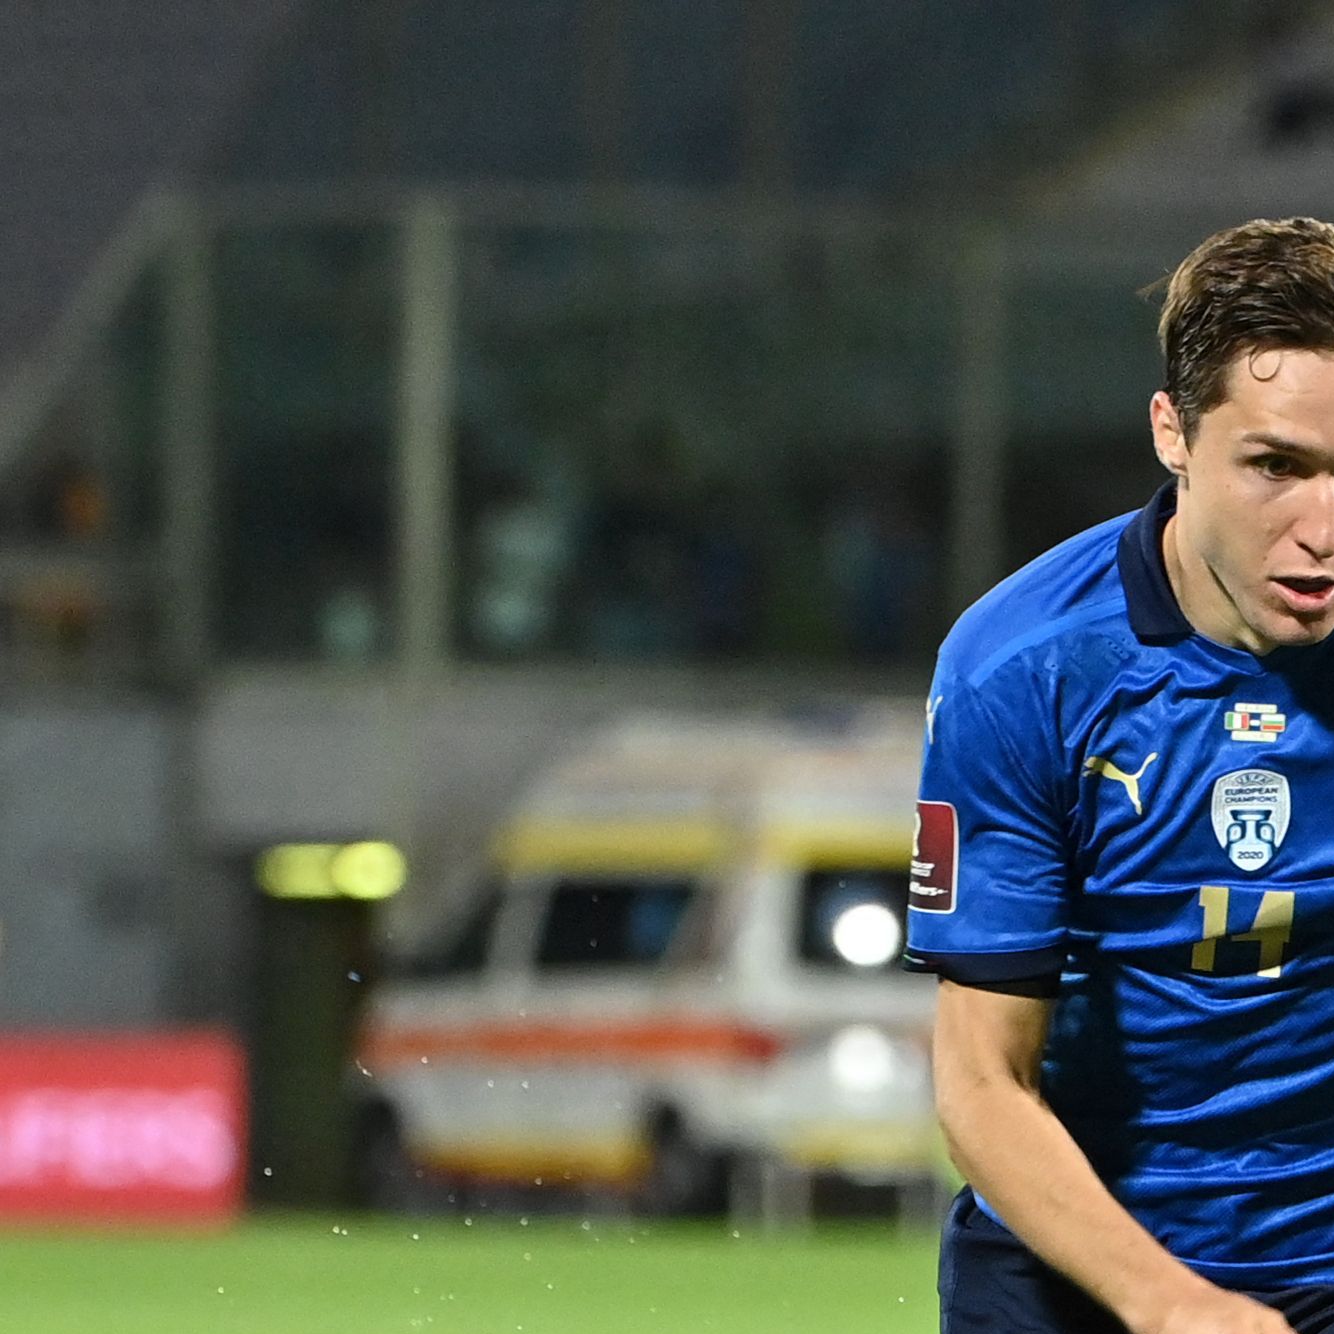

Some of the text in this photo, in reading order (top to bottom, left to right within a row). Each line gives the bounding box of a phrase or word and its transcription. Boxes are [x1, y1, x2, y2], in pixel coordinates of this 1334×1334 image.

[1224, 786, 1279, 796] EUROPEAN
[1224, 795, 1279, 803] CHAMPIONS
[1237, 851, 1264, 860] 2020
[1190, 885, 1296, 979] 14
